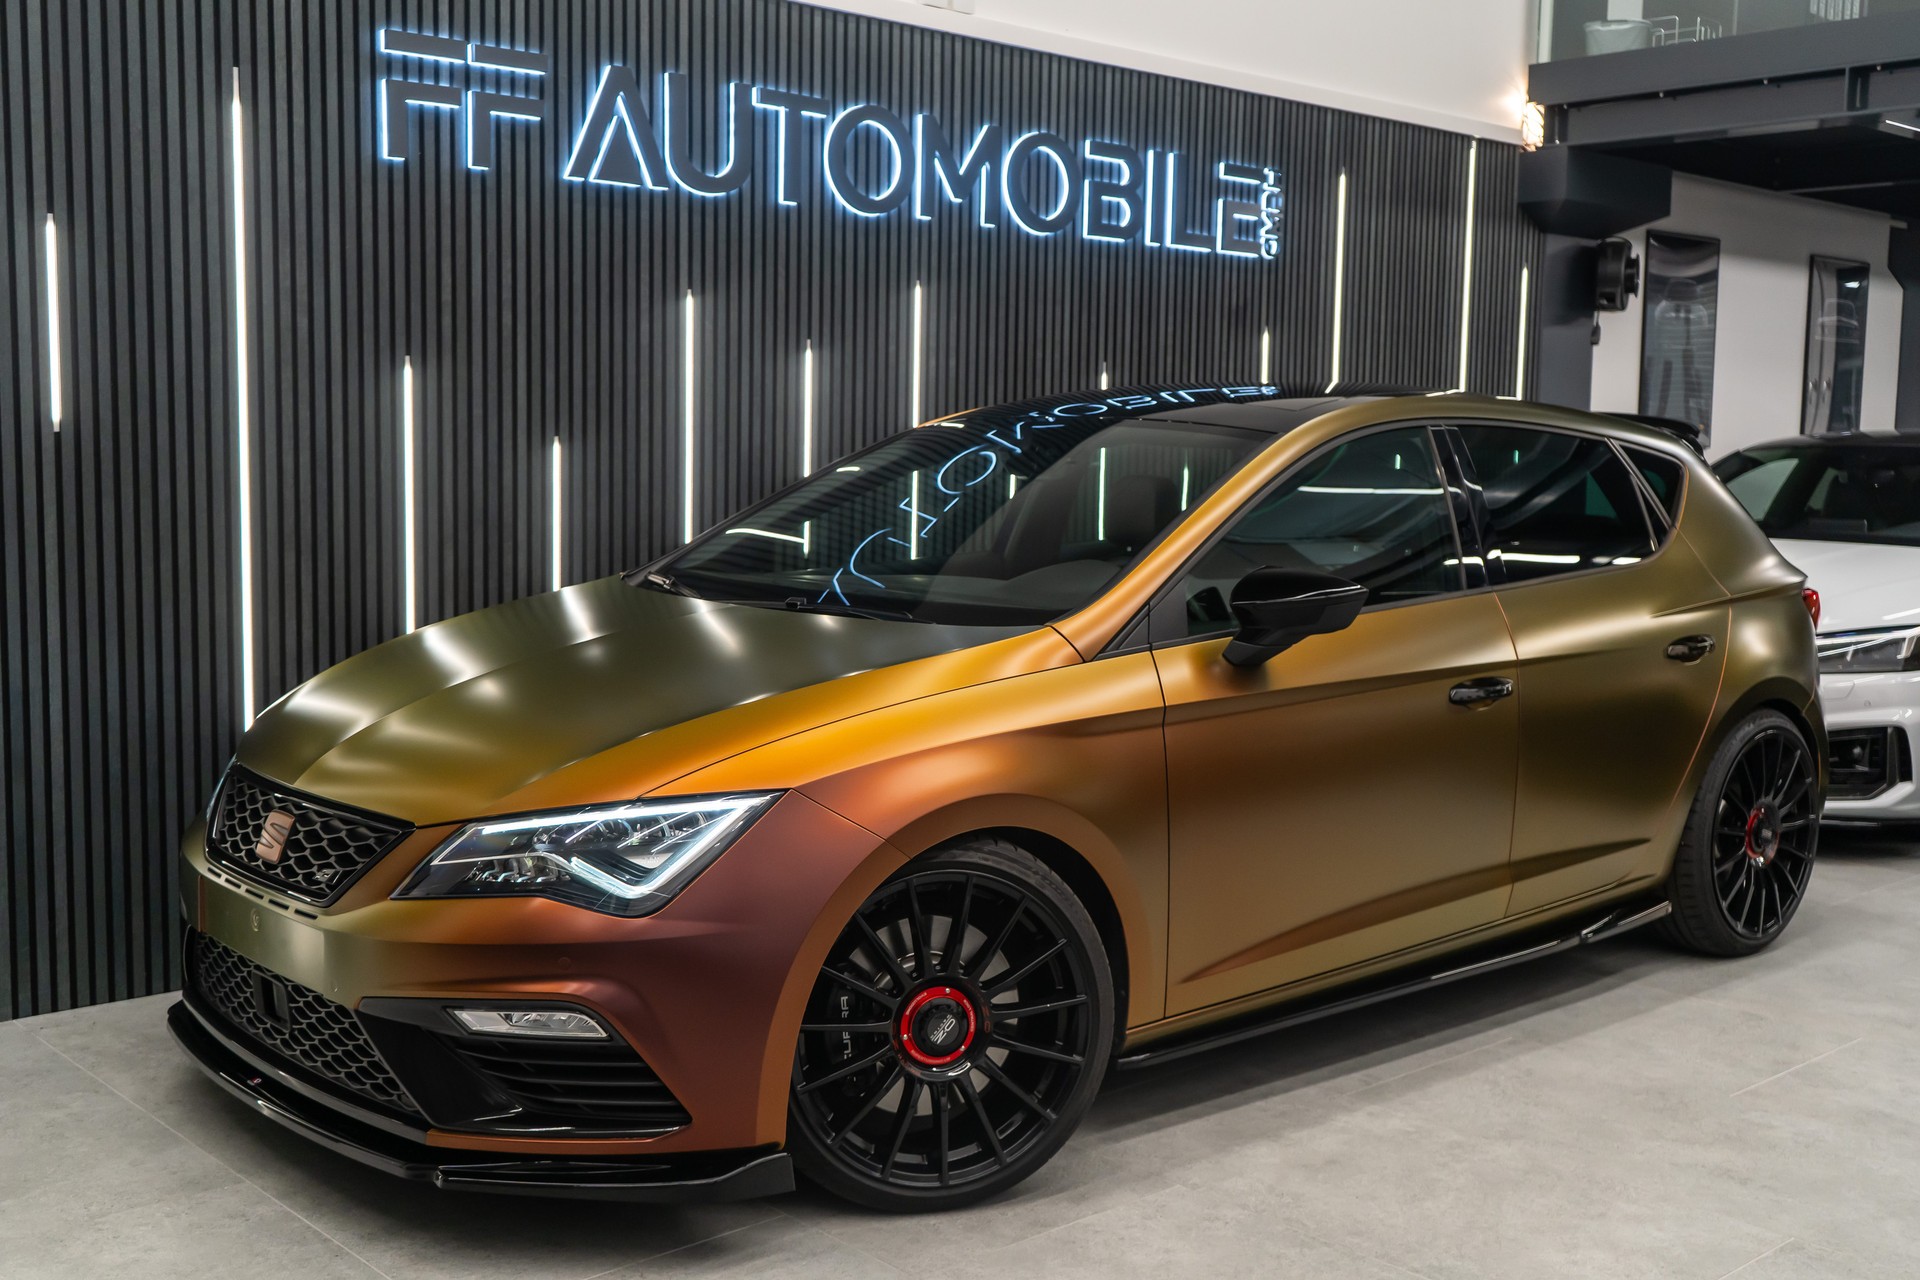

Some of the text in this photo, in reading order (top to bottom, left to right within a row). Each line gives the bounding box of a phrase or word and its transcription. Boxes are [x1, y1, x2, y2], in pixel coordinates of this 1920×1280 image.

[381, 28, 1263, 258] FF AUTOMOBILE
[840, 996, 852, 1060] UPRA
